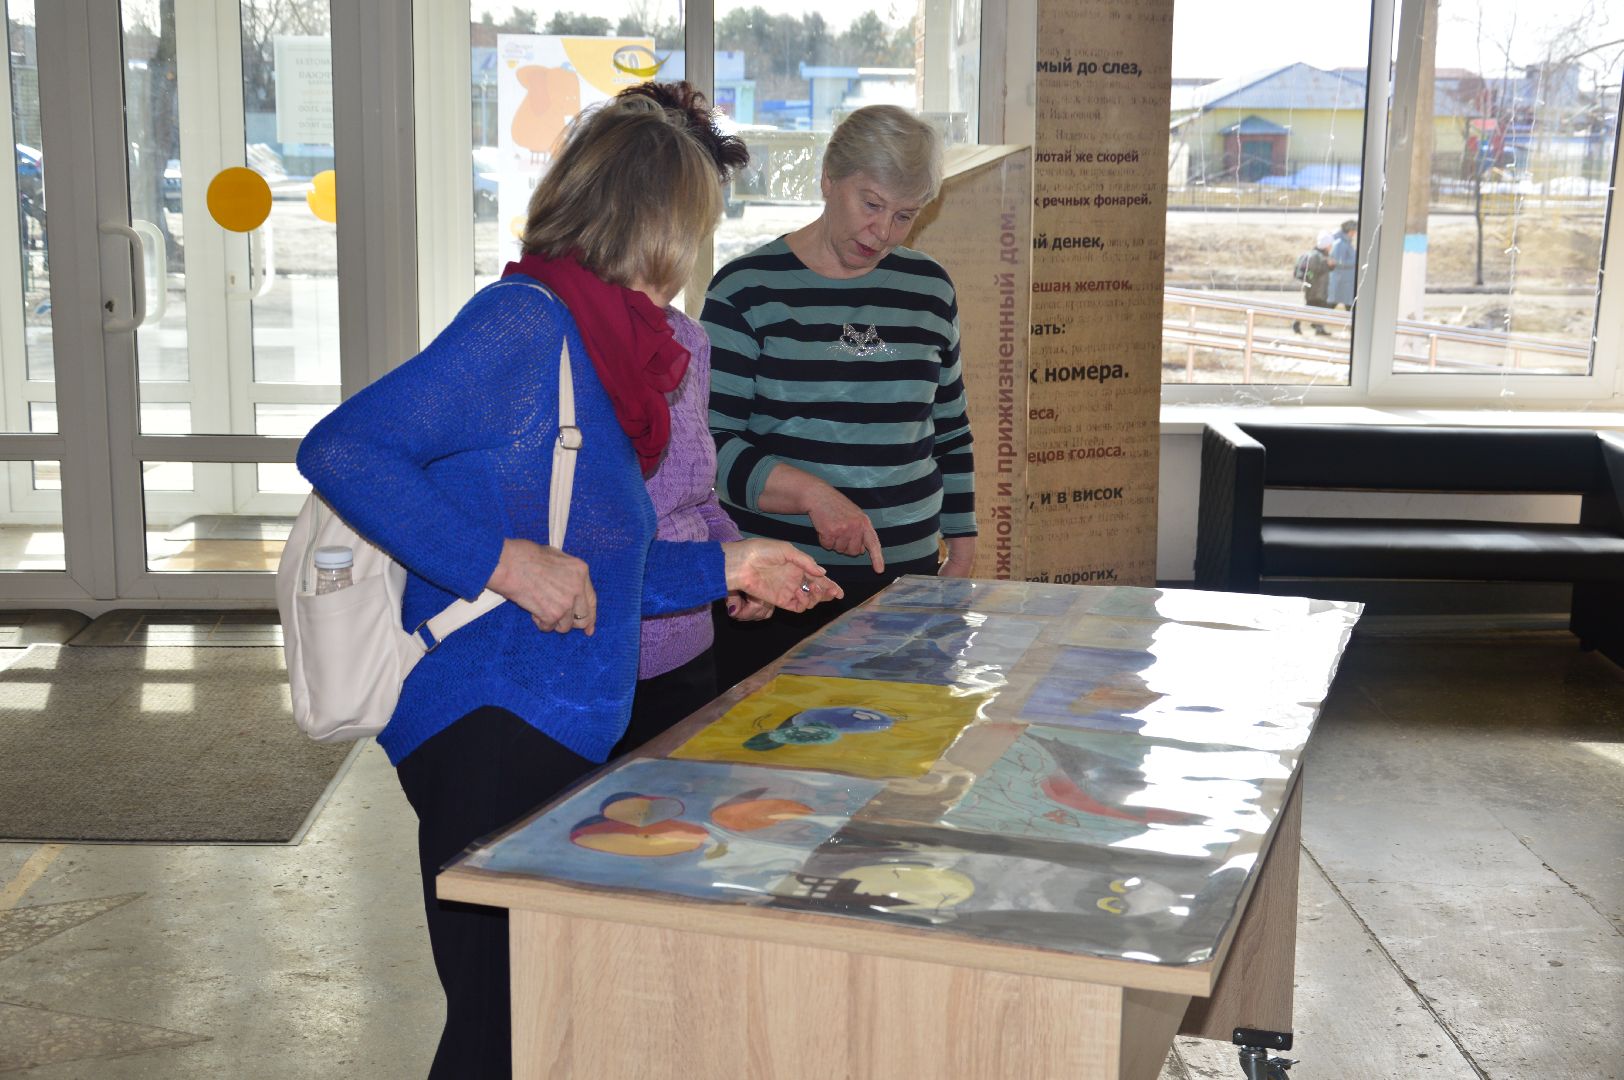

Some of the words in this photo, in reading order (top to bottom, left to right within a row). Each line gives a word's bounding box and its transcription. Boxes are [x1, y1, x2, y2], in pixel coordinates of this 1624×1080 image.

[1036, 57, 1072, 73] мый
[1077, 62, 1098, 76] до
[1102, 62, 1142, 77] слез,
[1034, 150, 1072, 163] лотай
[1076, 153, 1093, 163] же
[1097, 150, 1139, 164] скорей
[1042, 196, 1090, 209] речных
[1094, 193, 1152, 208] фонарей.
[999, 205, 1018, 265] дом.
[1051, 236, 1105, 251] денек,
[1032, 281, 1071, 293] ешан
[1075, 279, 1132, 291] желток.
[993, 273, 1017, 474] прижизненный
[1044, 364, 1129, 385] номера.
[1029, 407, 1059, 422] еса,
[1028, 448, 1065, 465] ецов
[1068, 446, 1126, 460] голоса.
[996, 483, 1011, 496] и
[1041, 492, 1051, 505] и
[1057, 491, 1067, 504] в
[1072, 487, 1123, 503] висок
[1053, 568, 1118, 585] дорогих,
